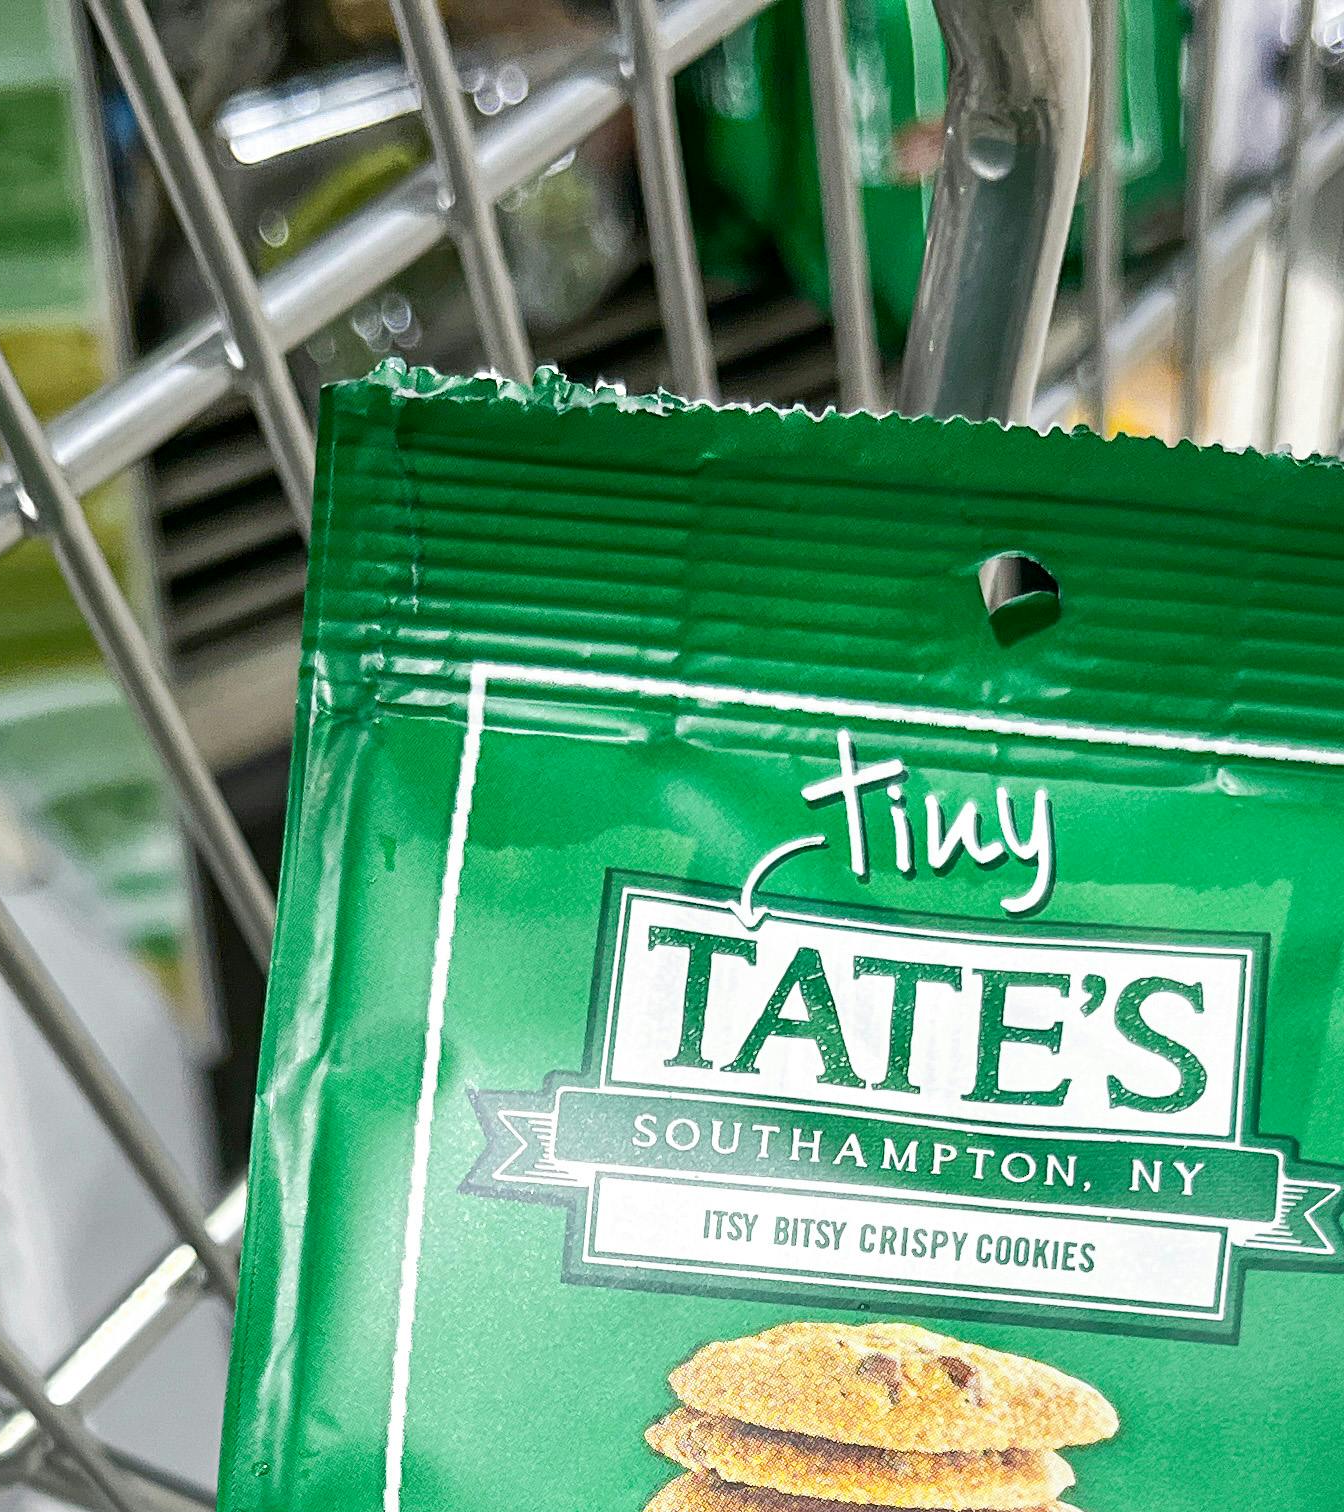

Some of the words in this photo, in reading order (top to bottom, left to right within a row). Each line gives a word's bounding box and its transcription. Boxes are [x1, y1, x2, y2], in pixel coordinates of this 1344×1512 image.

[802, 730, 1056, 913] tiny
[648, 926, 1208, 1114] TATE'S
[632, 1114, 1094, 1192] SOUTHAMPTON,
[1129, 1160, 1205, 1197] NY
[702, 1210, 758, 1242] ITSY
[773, 1217, 846, 1251] BITSY
[858, 1225, 965, 1262] CRISPY
[975, 1234, 1097, 1273] COOKIES
